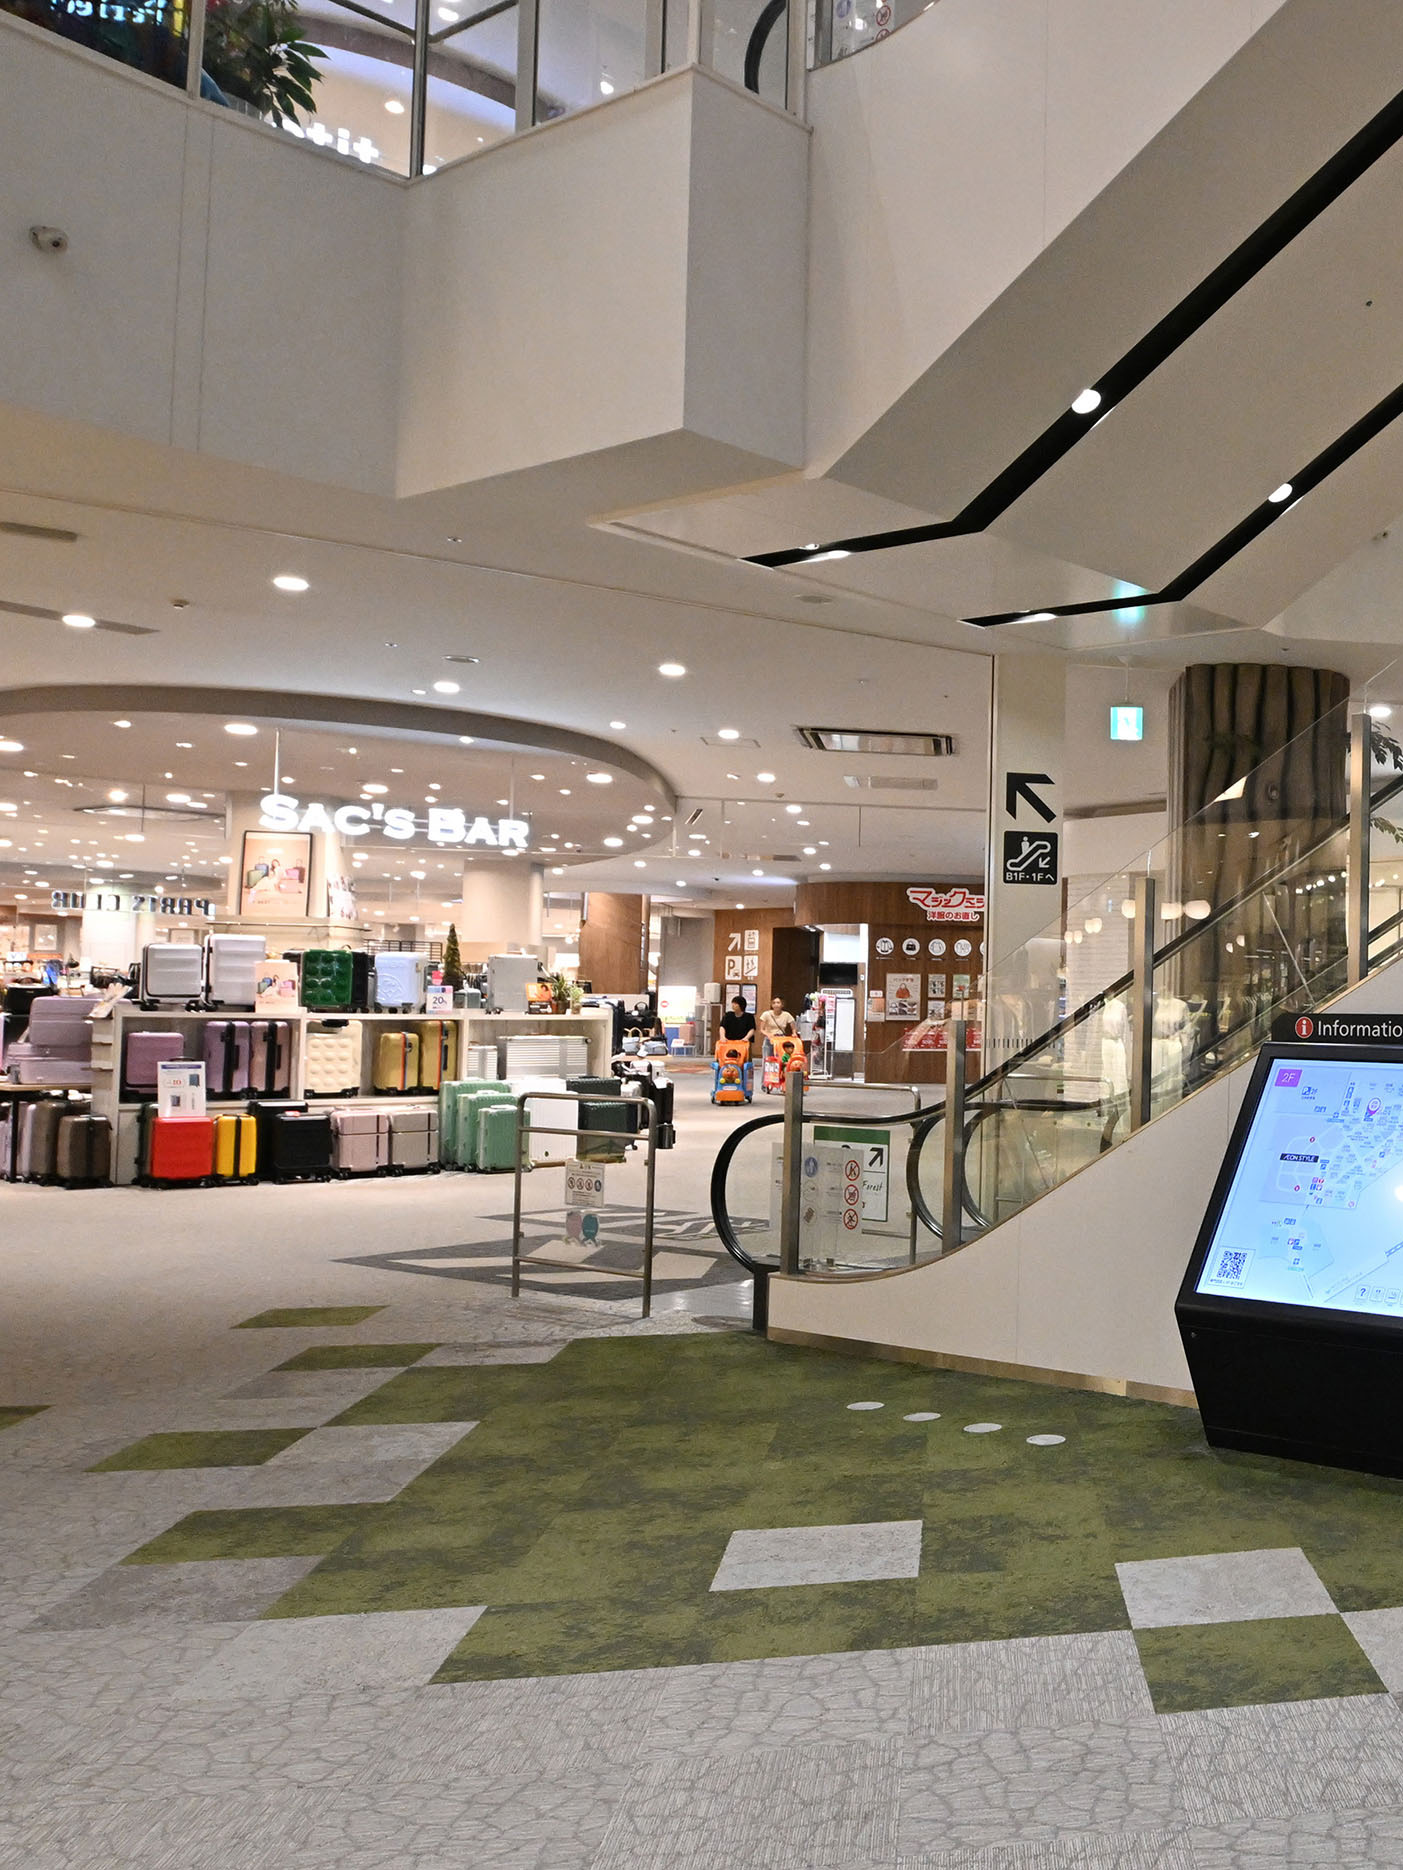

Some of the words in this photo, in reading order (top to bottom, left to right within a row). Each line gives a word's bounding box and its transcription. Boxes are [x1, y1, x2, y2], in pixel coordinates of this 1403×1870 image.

[259, 793, 416, 840] SAC'S
[427, 808, 530, 848] BAR
[1281, 1072, 1296, 1083] 2F
[862, 1180, 883, 1191] Forest
